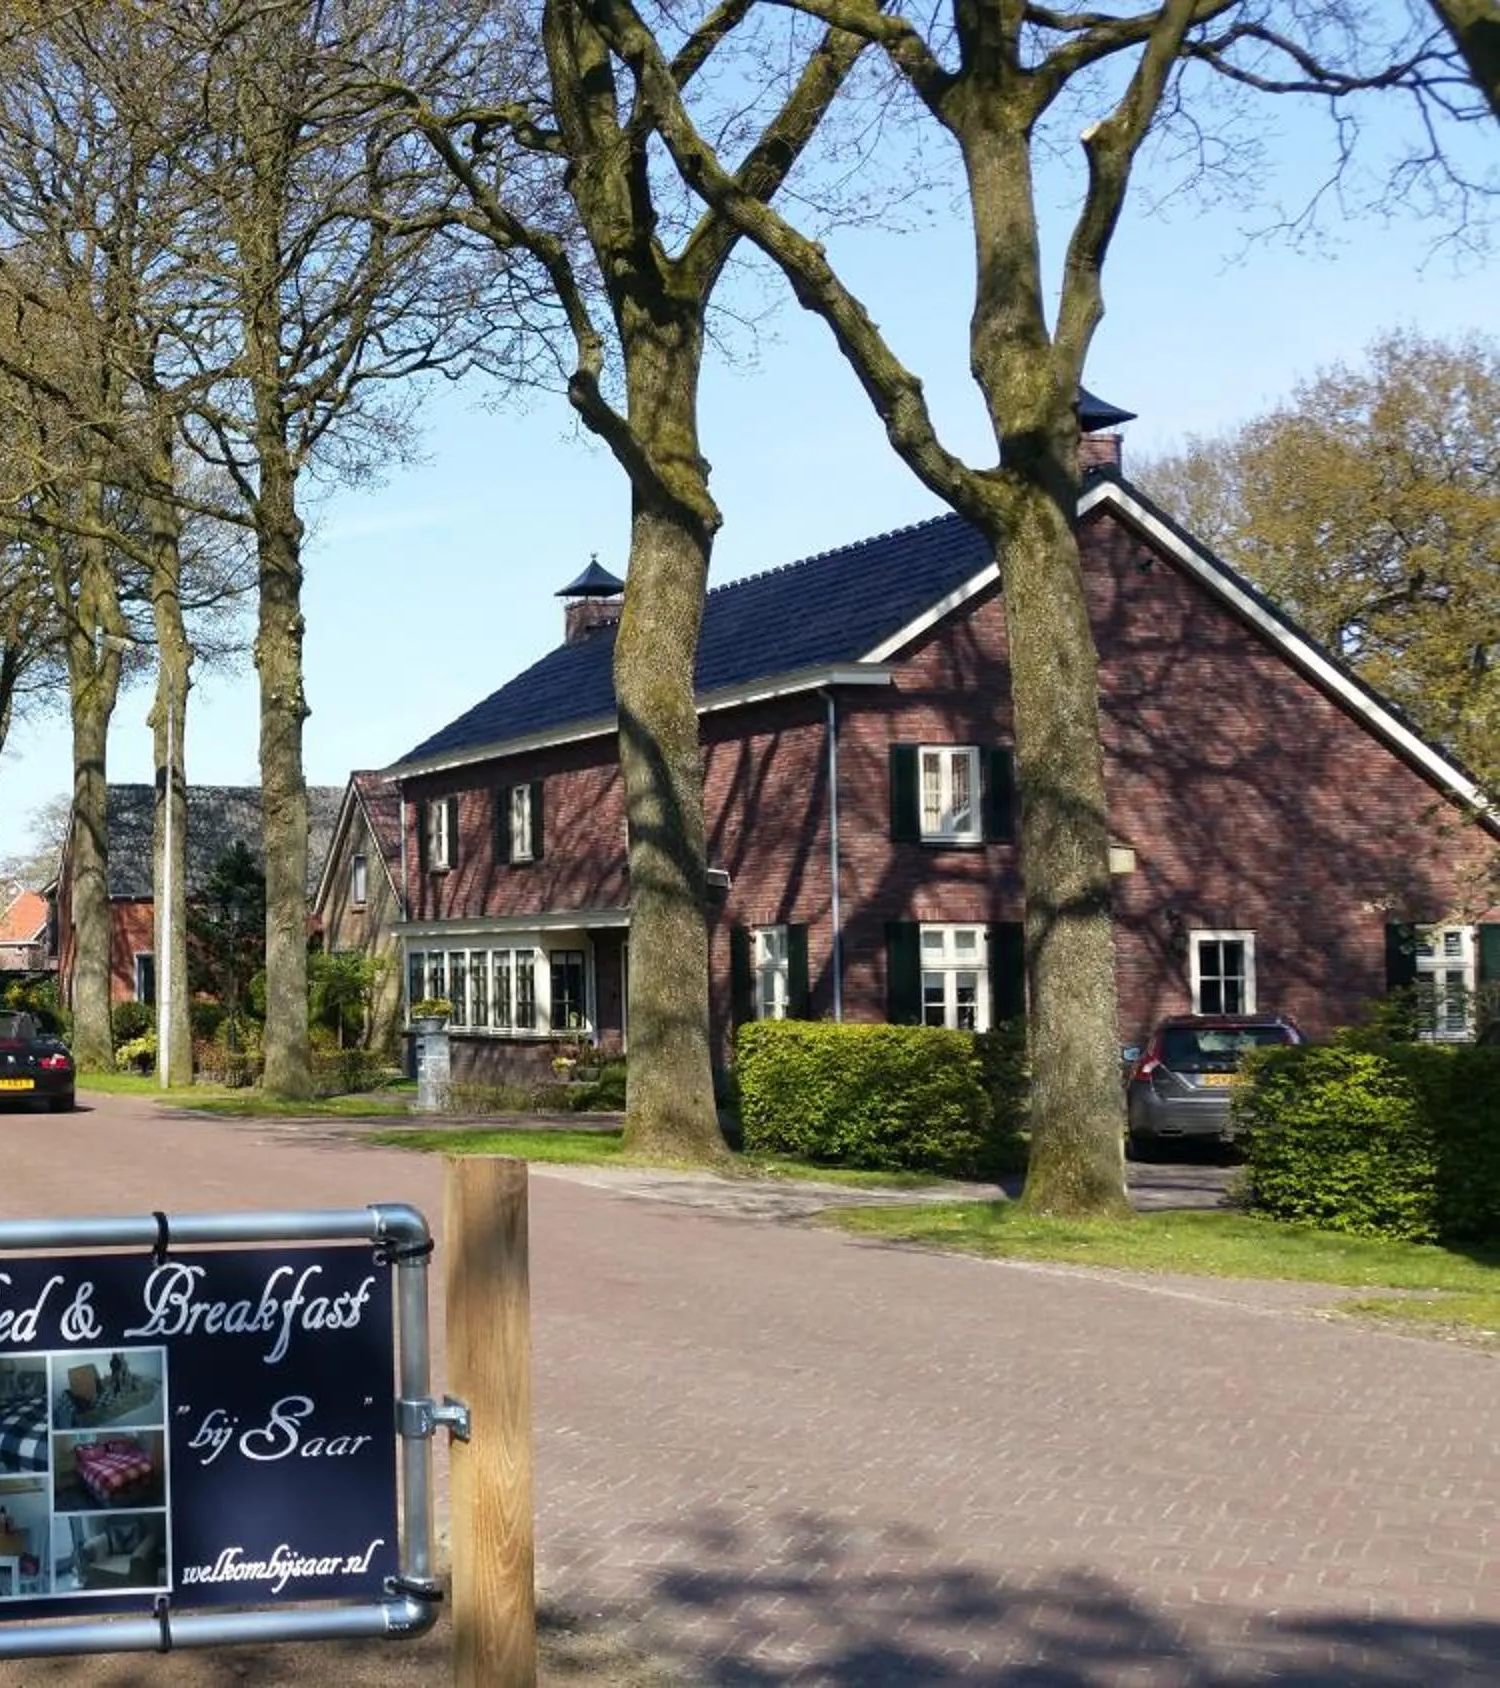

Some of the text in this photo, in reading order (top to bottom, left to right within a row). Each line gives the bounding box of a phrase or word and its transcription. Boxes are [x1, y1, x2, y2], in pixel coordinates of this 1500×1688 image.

[60, 1281, 102, 1342] &
[124, 1262, 376, 1364] Breakfast
[182, 1540, 385, 1593] welkombijsaar.nl
